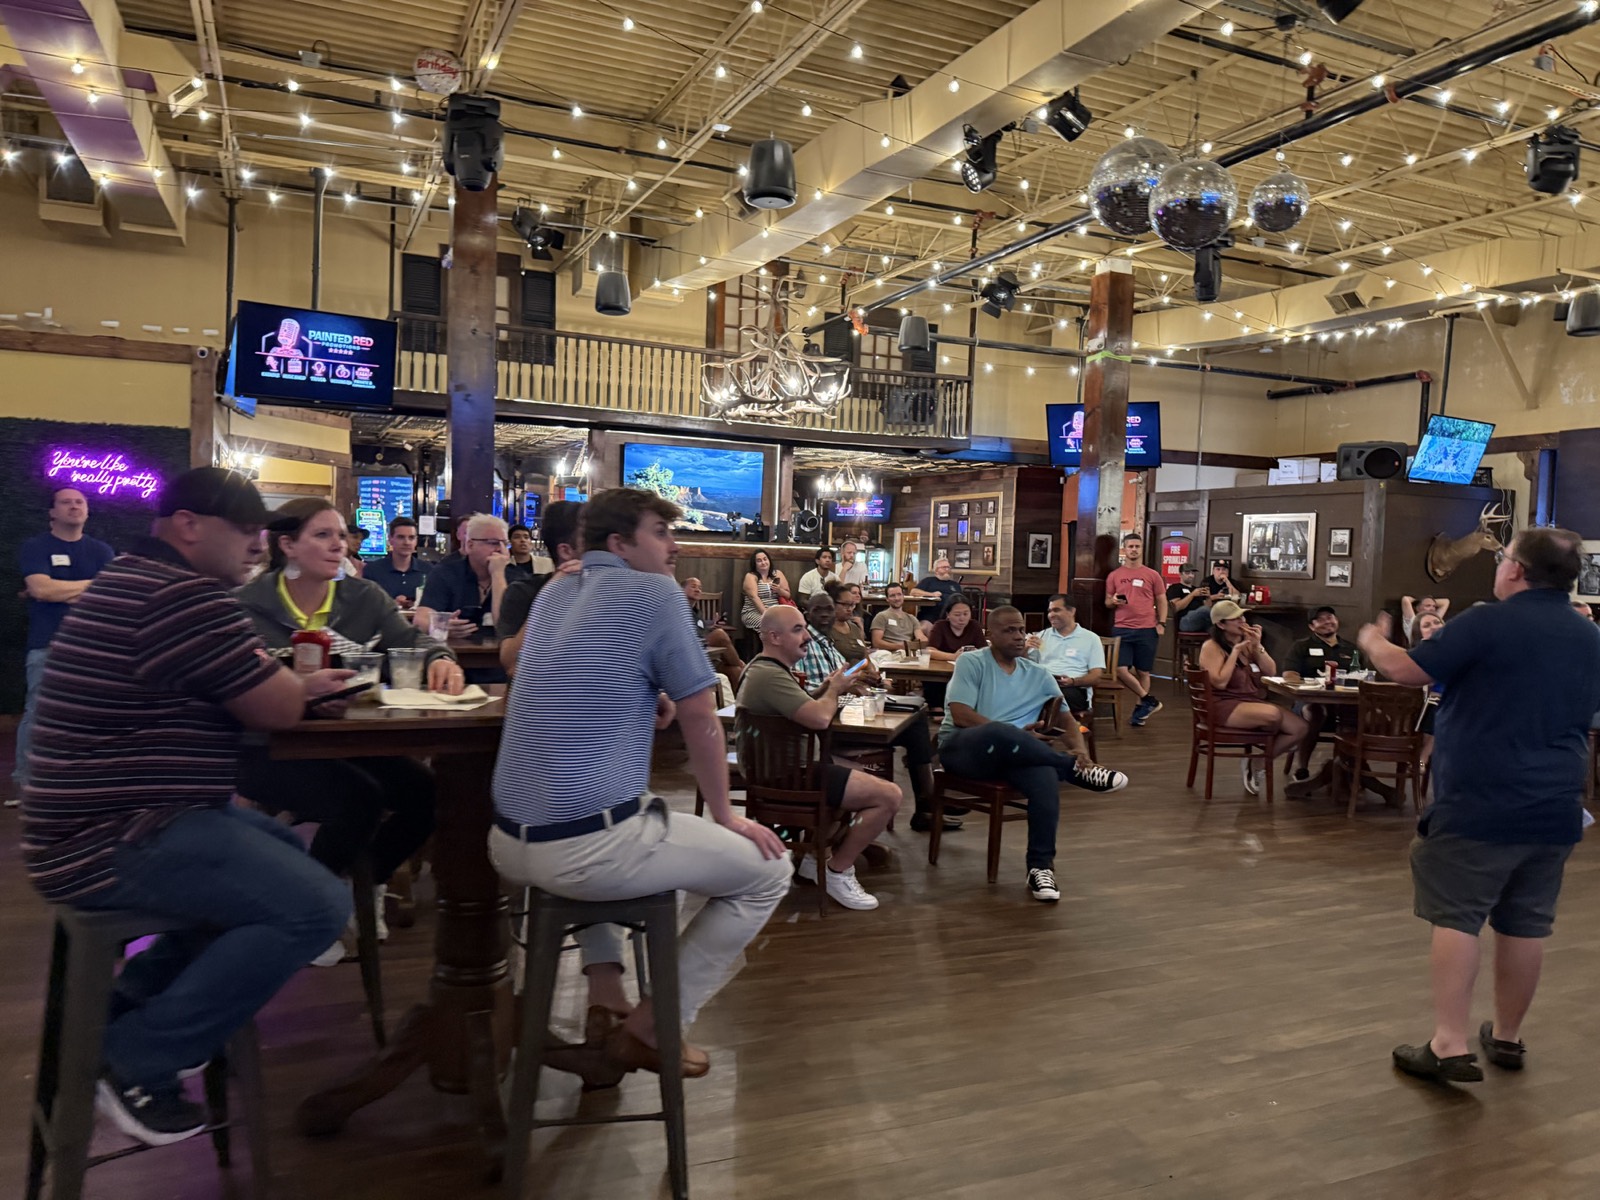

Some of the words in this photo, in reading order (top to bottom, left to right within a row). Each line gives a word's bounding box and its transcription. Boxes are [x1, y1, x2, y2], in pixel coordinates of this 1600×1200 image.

[308, 330, 353, 344] PAINTED
[353, 335, 374, 347] RED
[49, 451, 101, 477] You're
[100, 454, 129, 472] like
[71, 471, 114, 494] really
[110, 472, 157, 498] pretty
[1170, 545, 1181, 555] FIRE
[1163, 555, 1188, 564] SPRINKLER
